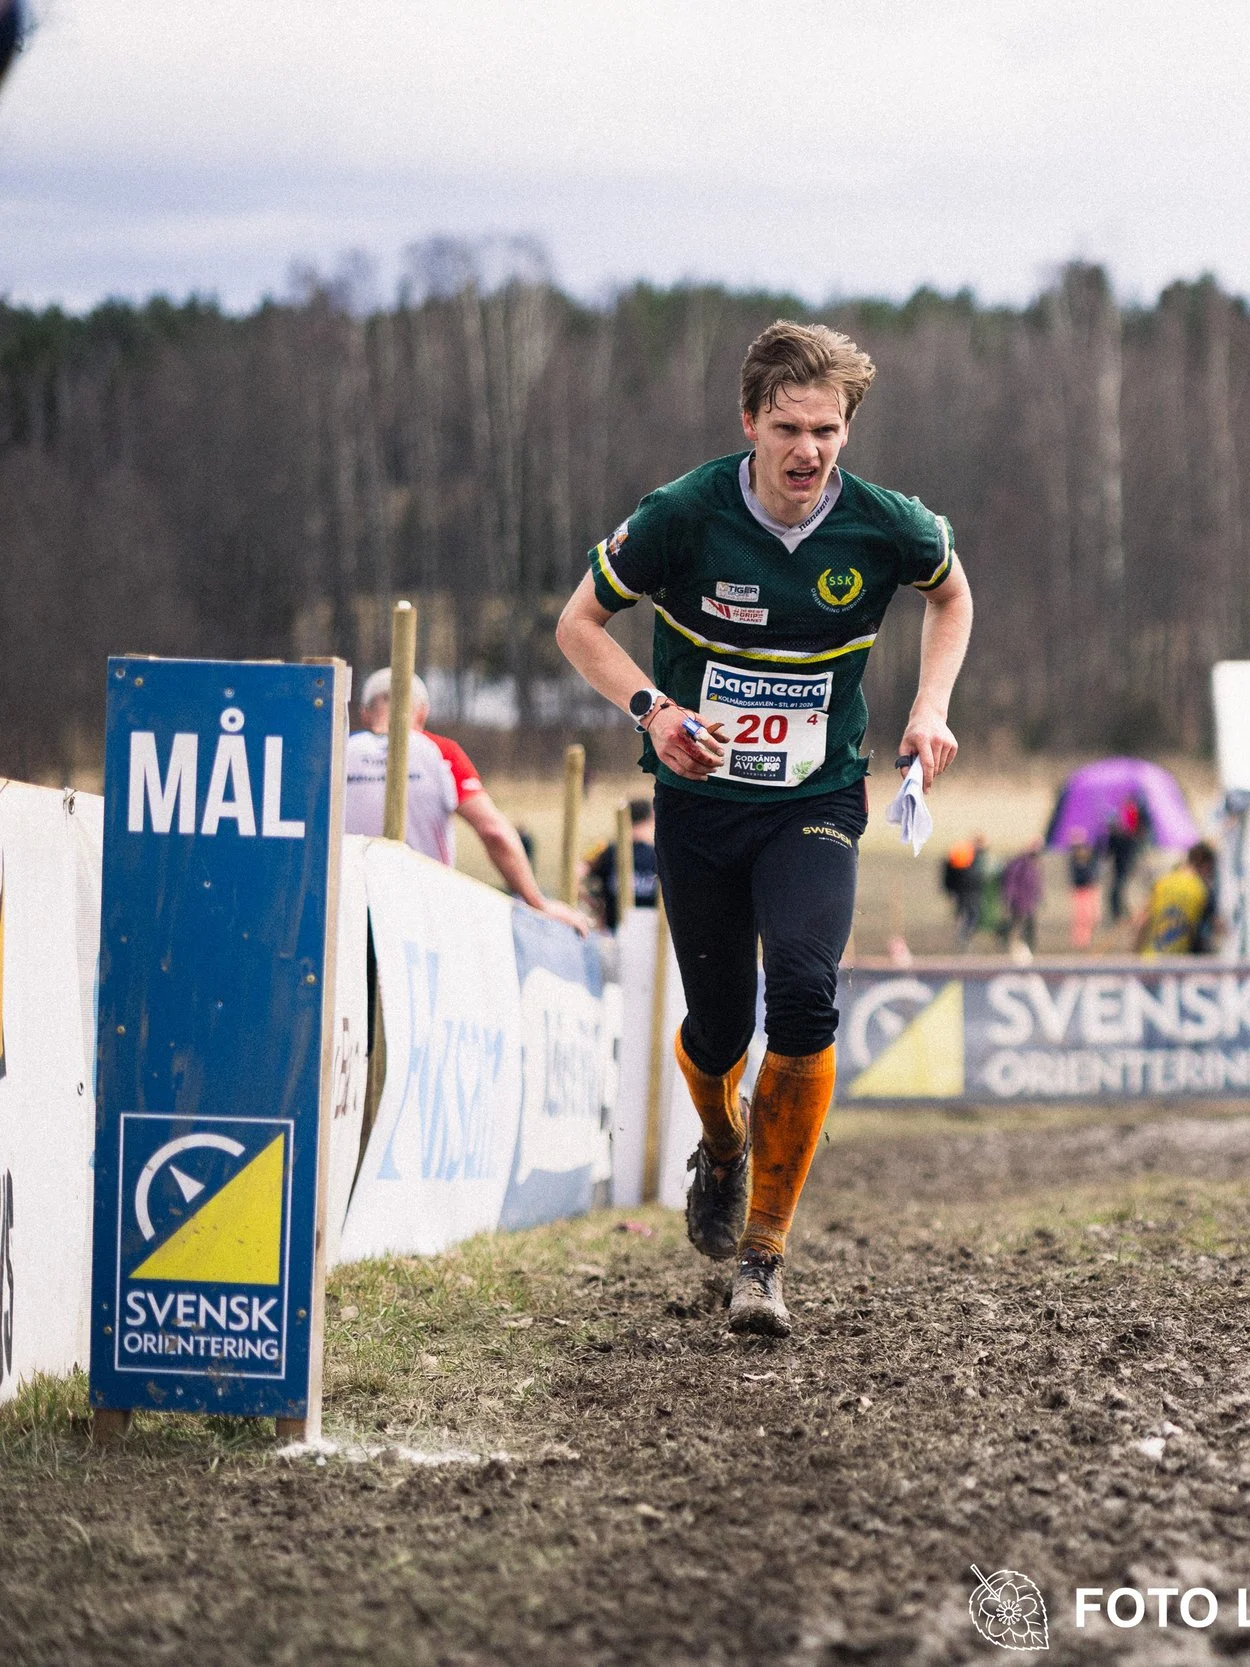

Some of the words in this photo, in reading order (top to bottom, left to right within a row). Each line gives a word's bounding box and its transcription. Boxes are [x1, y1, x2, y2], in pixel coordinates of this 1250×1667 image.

[799, 494, 831, 532] noname
[728, 585, 758, 594] TIGER
[829, 575, 853, 586] SSK
[709, 670, 826, 698] bagheera
[718, 695, 774, 707] KOLMÅRDSKAVLEN
[733, 714, 788, 744] 20
[807, 714, 818, 725] 4
[128, 707, 306, 838] MÅL
[735, 754, 782, 763] GODKÄNDA
[802, 826, 853, 848] SWEDEN
[125, 1290, 279, 1332] SVENSK
[123, 1332, 279, 1361] ORIENTERING
